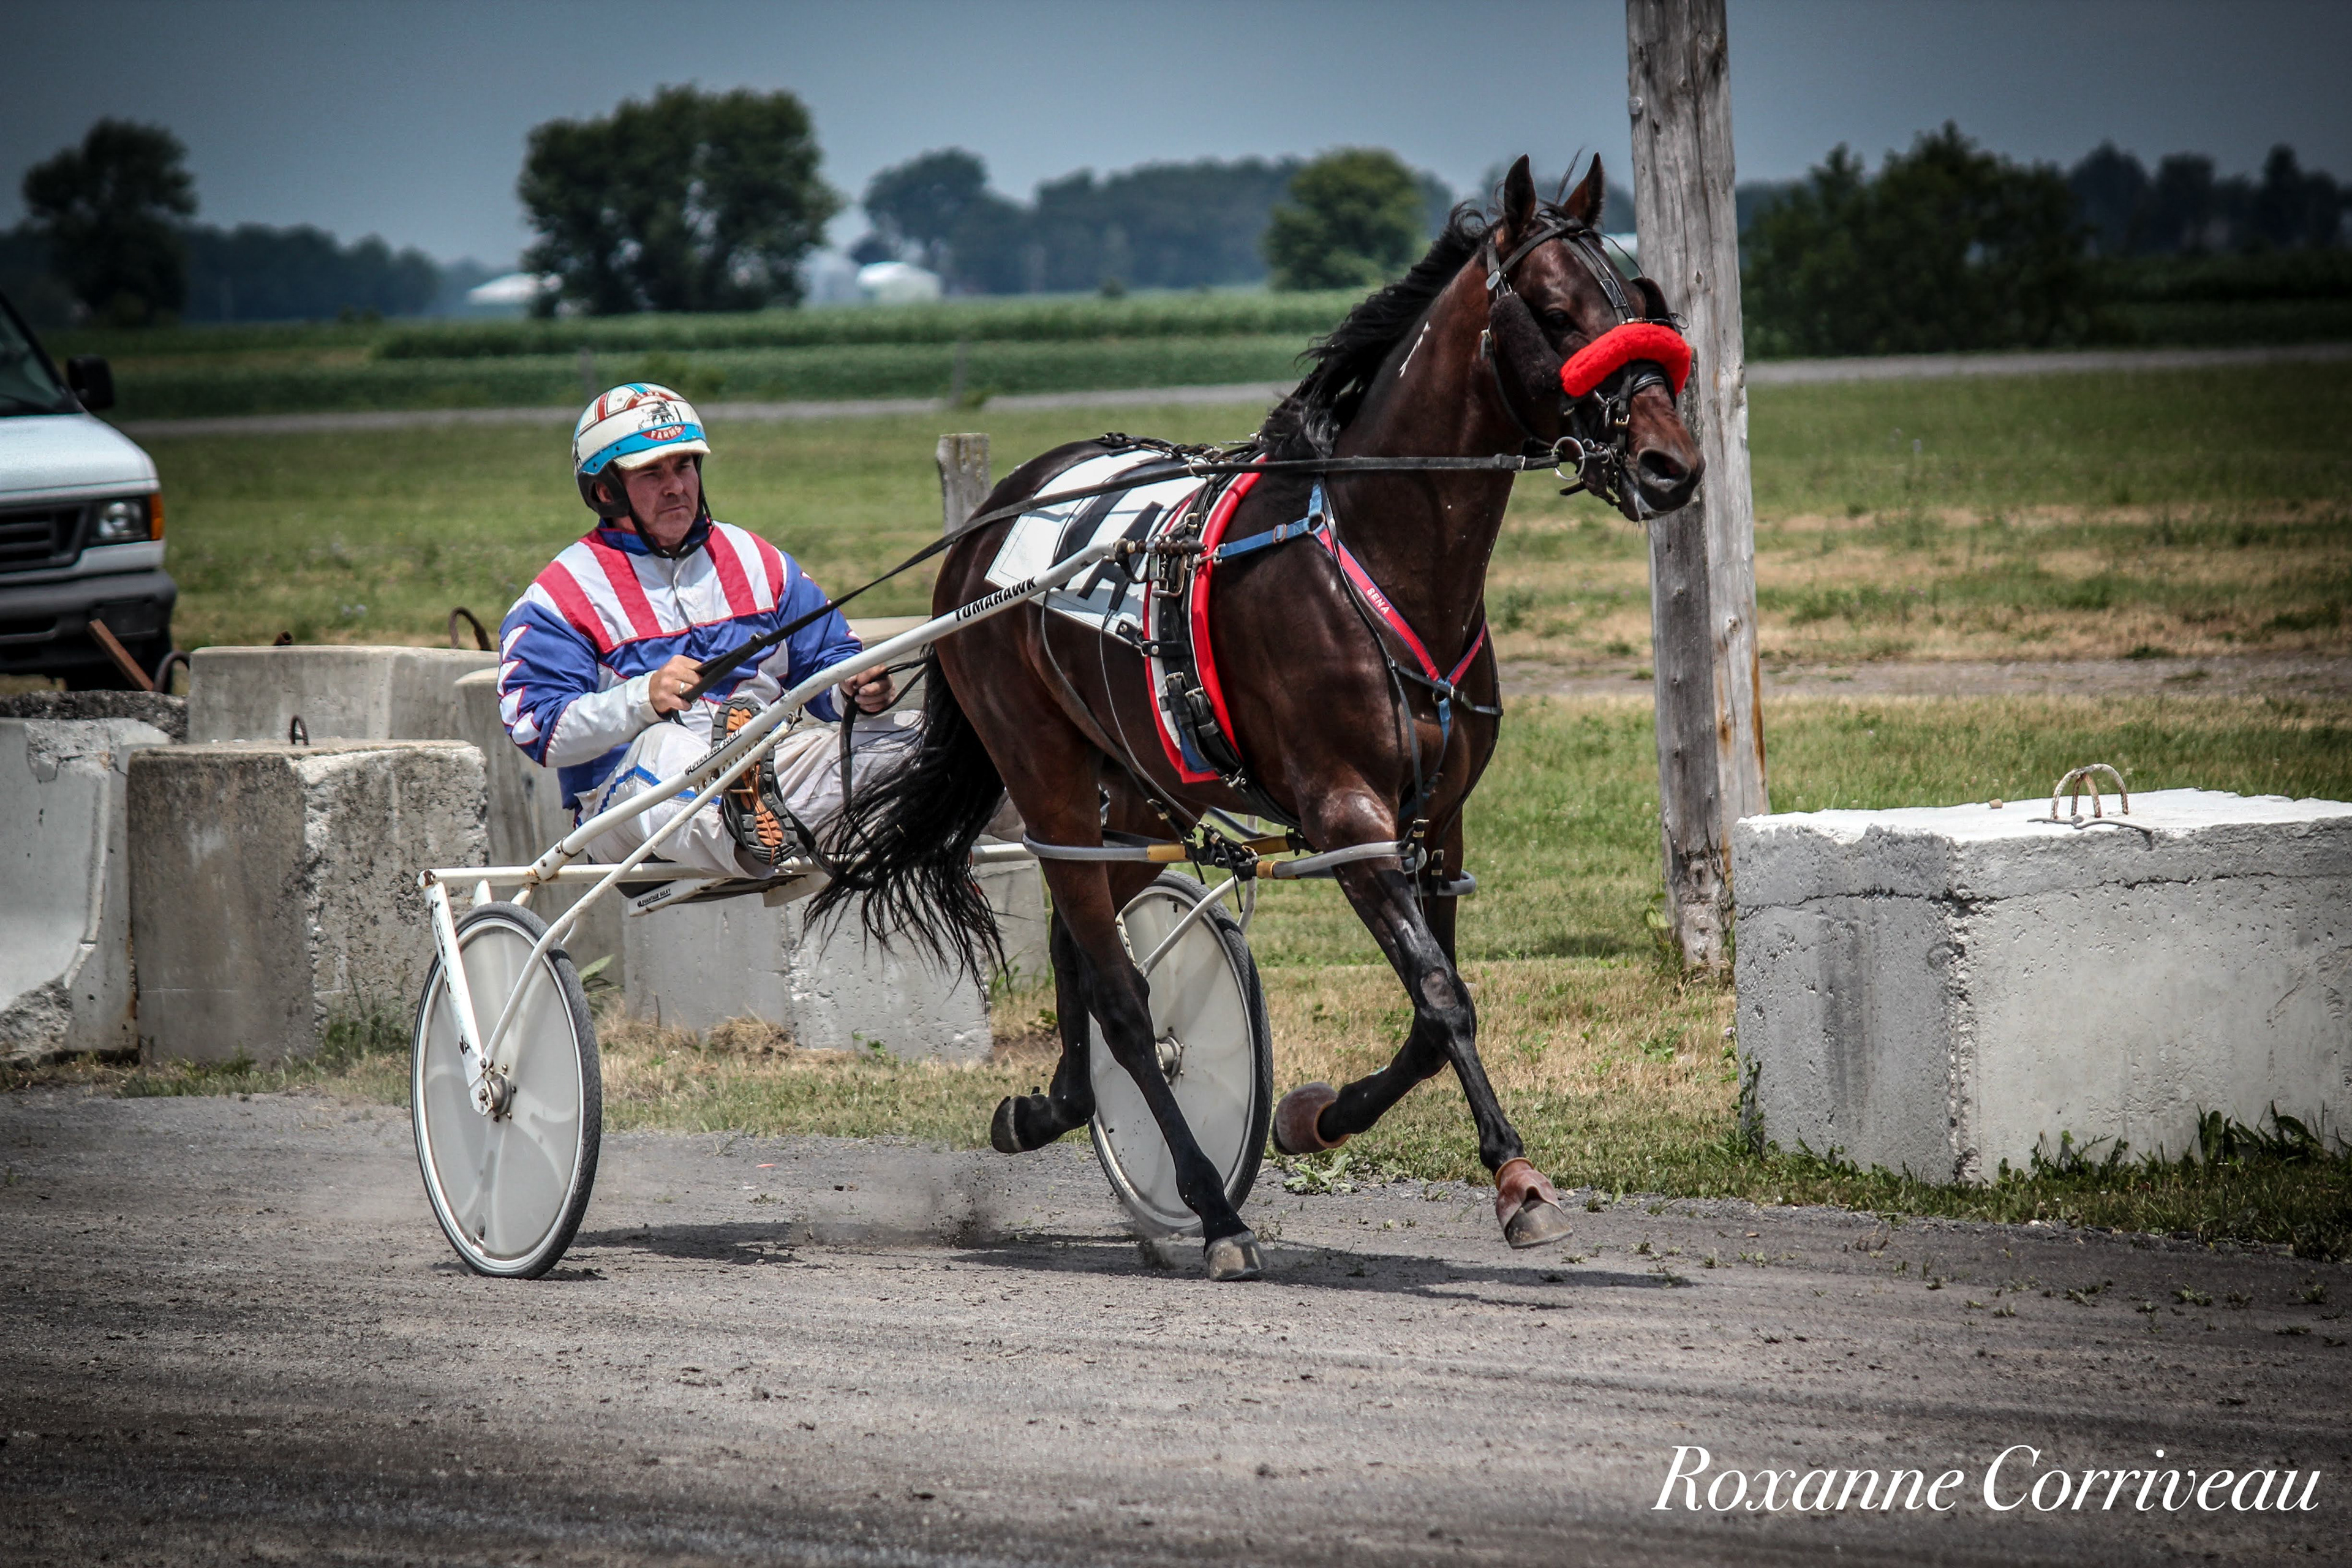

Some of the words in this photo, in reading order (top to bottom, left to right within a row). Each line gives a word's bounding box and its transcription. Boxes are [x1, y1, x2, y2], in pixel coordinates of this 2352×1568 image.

[650, 426, 682, 440] FARMS
[954, 576, 1037, 622] TOMAHAWK
[1366, 587, 1390, 614] SENA
[637, 892, 660, 908] ADVANTAGE
[660, 888, 671, 897] SULKY
